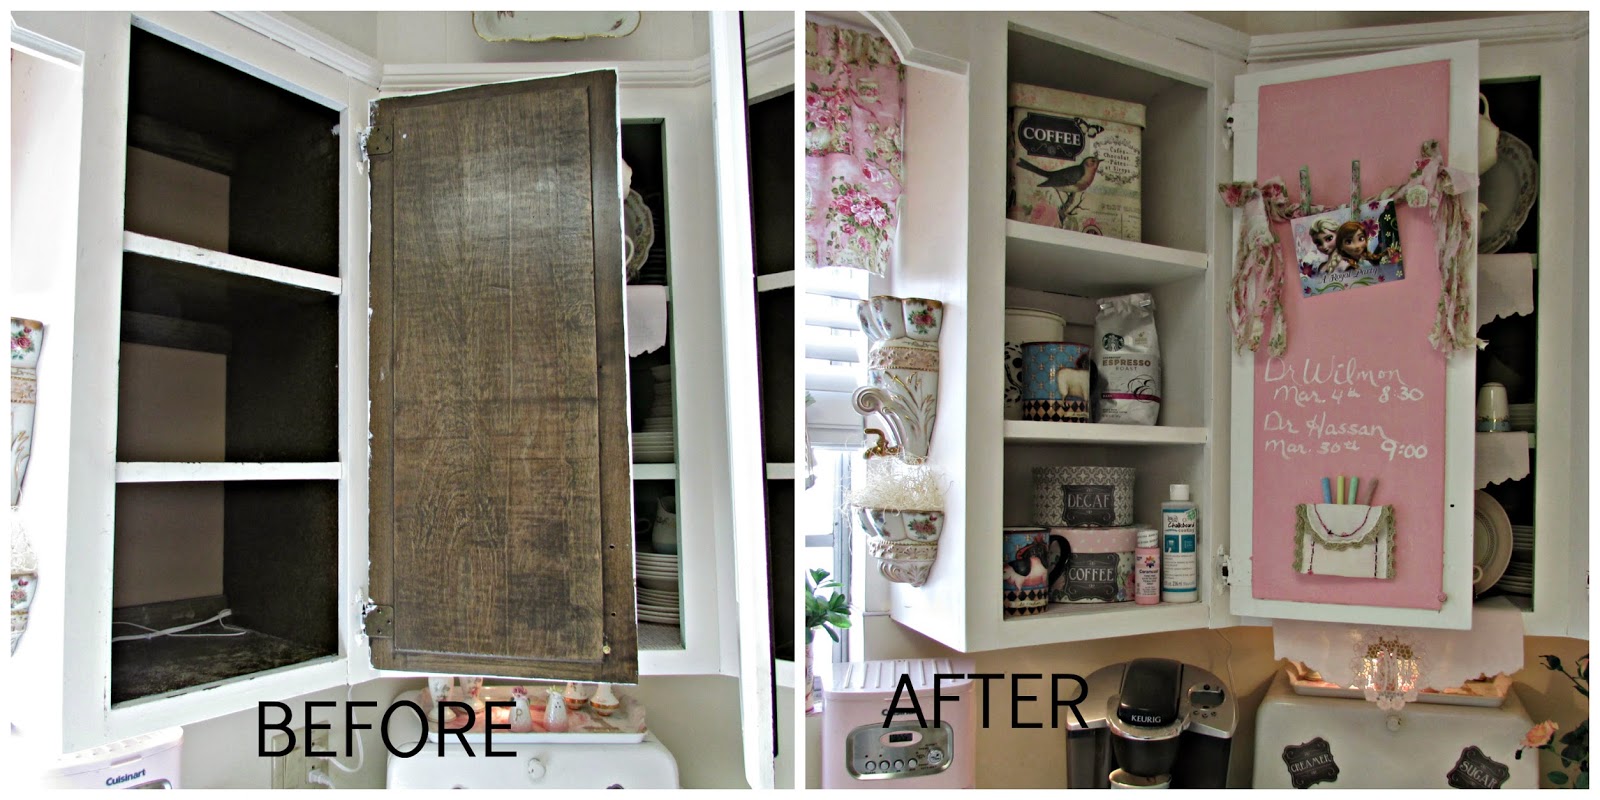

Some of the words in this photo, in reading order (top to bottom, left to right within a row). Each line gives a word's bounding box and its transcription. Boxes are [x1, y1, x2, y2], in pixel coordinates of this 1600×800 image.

[1023, 127, 1081, 146] COFFEE
[1329, 271, 1351, 282] Royal
[1353, 268, 1378, 278] Party
[1102, 359, 1151, 367] ESPRESSO
[1264, 356, 1301, 386] Dr
[1303, 355, 1408, 387] Wilmon
[1378, 386, 1424, 404] 8:30
[1264, 410, 1299, 434] Dr
[1306, 411, 1390, 440] Hassan
[1381, 438, 1428, 461] 9:00
[1067, 493, 1111, 508] DECAF
[1068, 568, 1114, 582] COFFEE
[1131, 714, 1162, 724] KEURIG
[1290, 753, 1332, 773] CREAMER
[105, 768, 146, 786] Cuisinart
[1459, 760, 1498, 789] SUGAR
